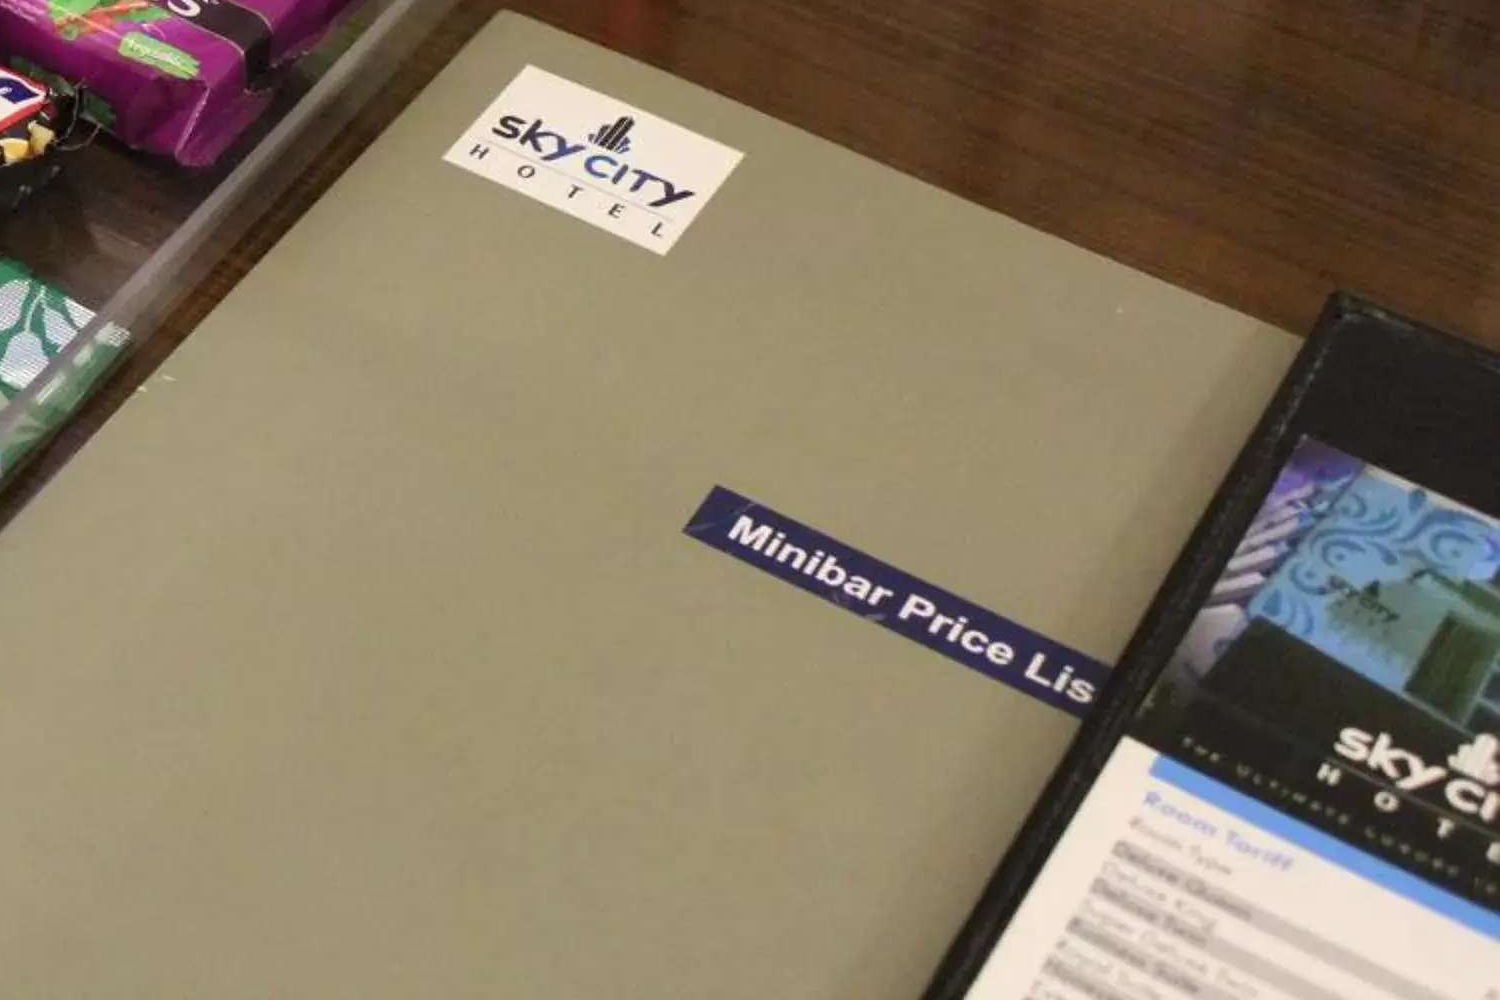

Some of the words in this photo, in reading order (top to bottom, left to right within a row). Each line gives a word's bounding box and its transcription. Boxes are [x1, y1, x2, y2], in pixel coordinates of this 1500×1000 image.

[468, 143, 666, 239] HOTEL
[727, 514, 895, 608] Minibar
[898, 593, 1016, 667] Price
[1023, 652, 1098, 706] Lis
[1143, 791, 1219, 838] Room
